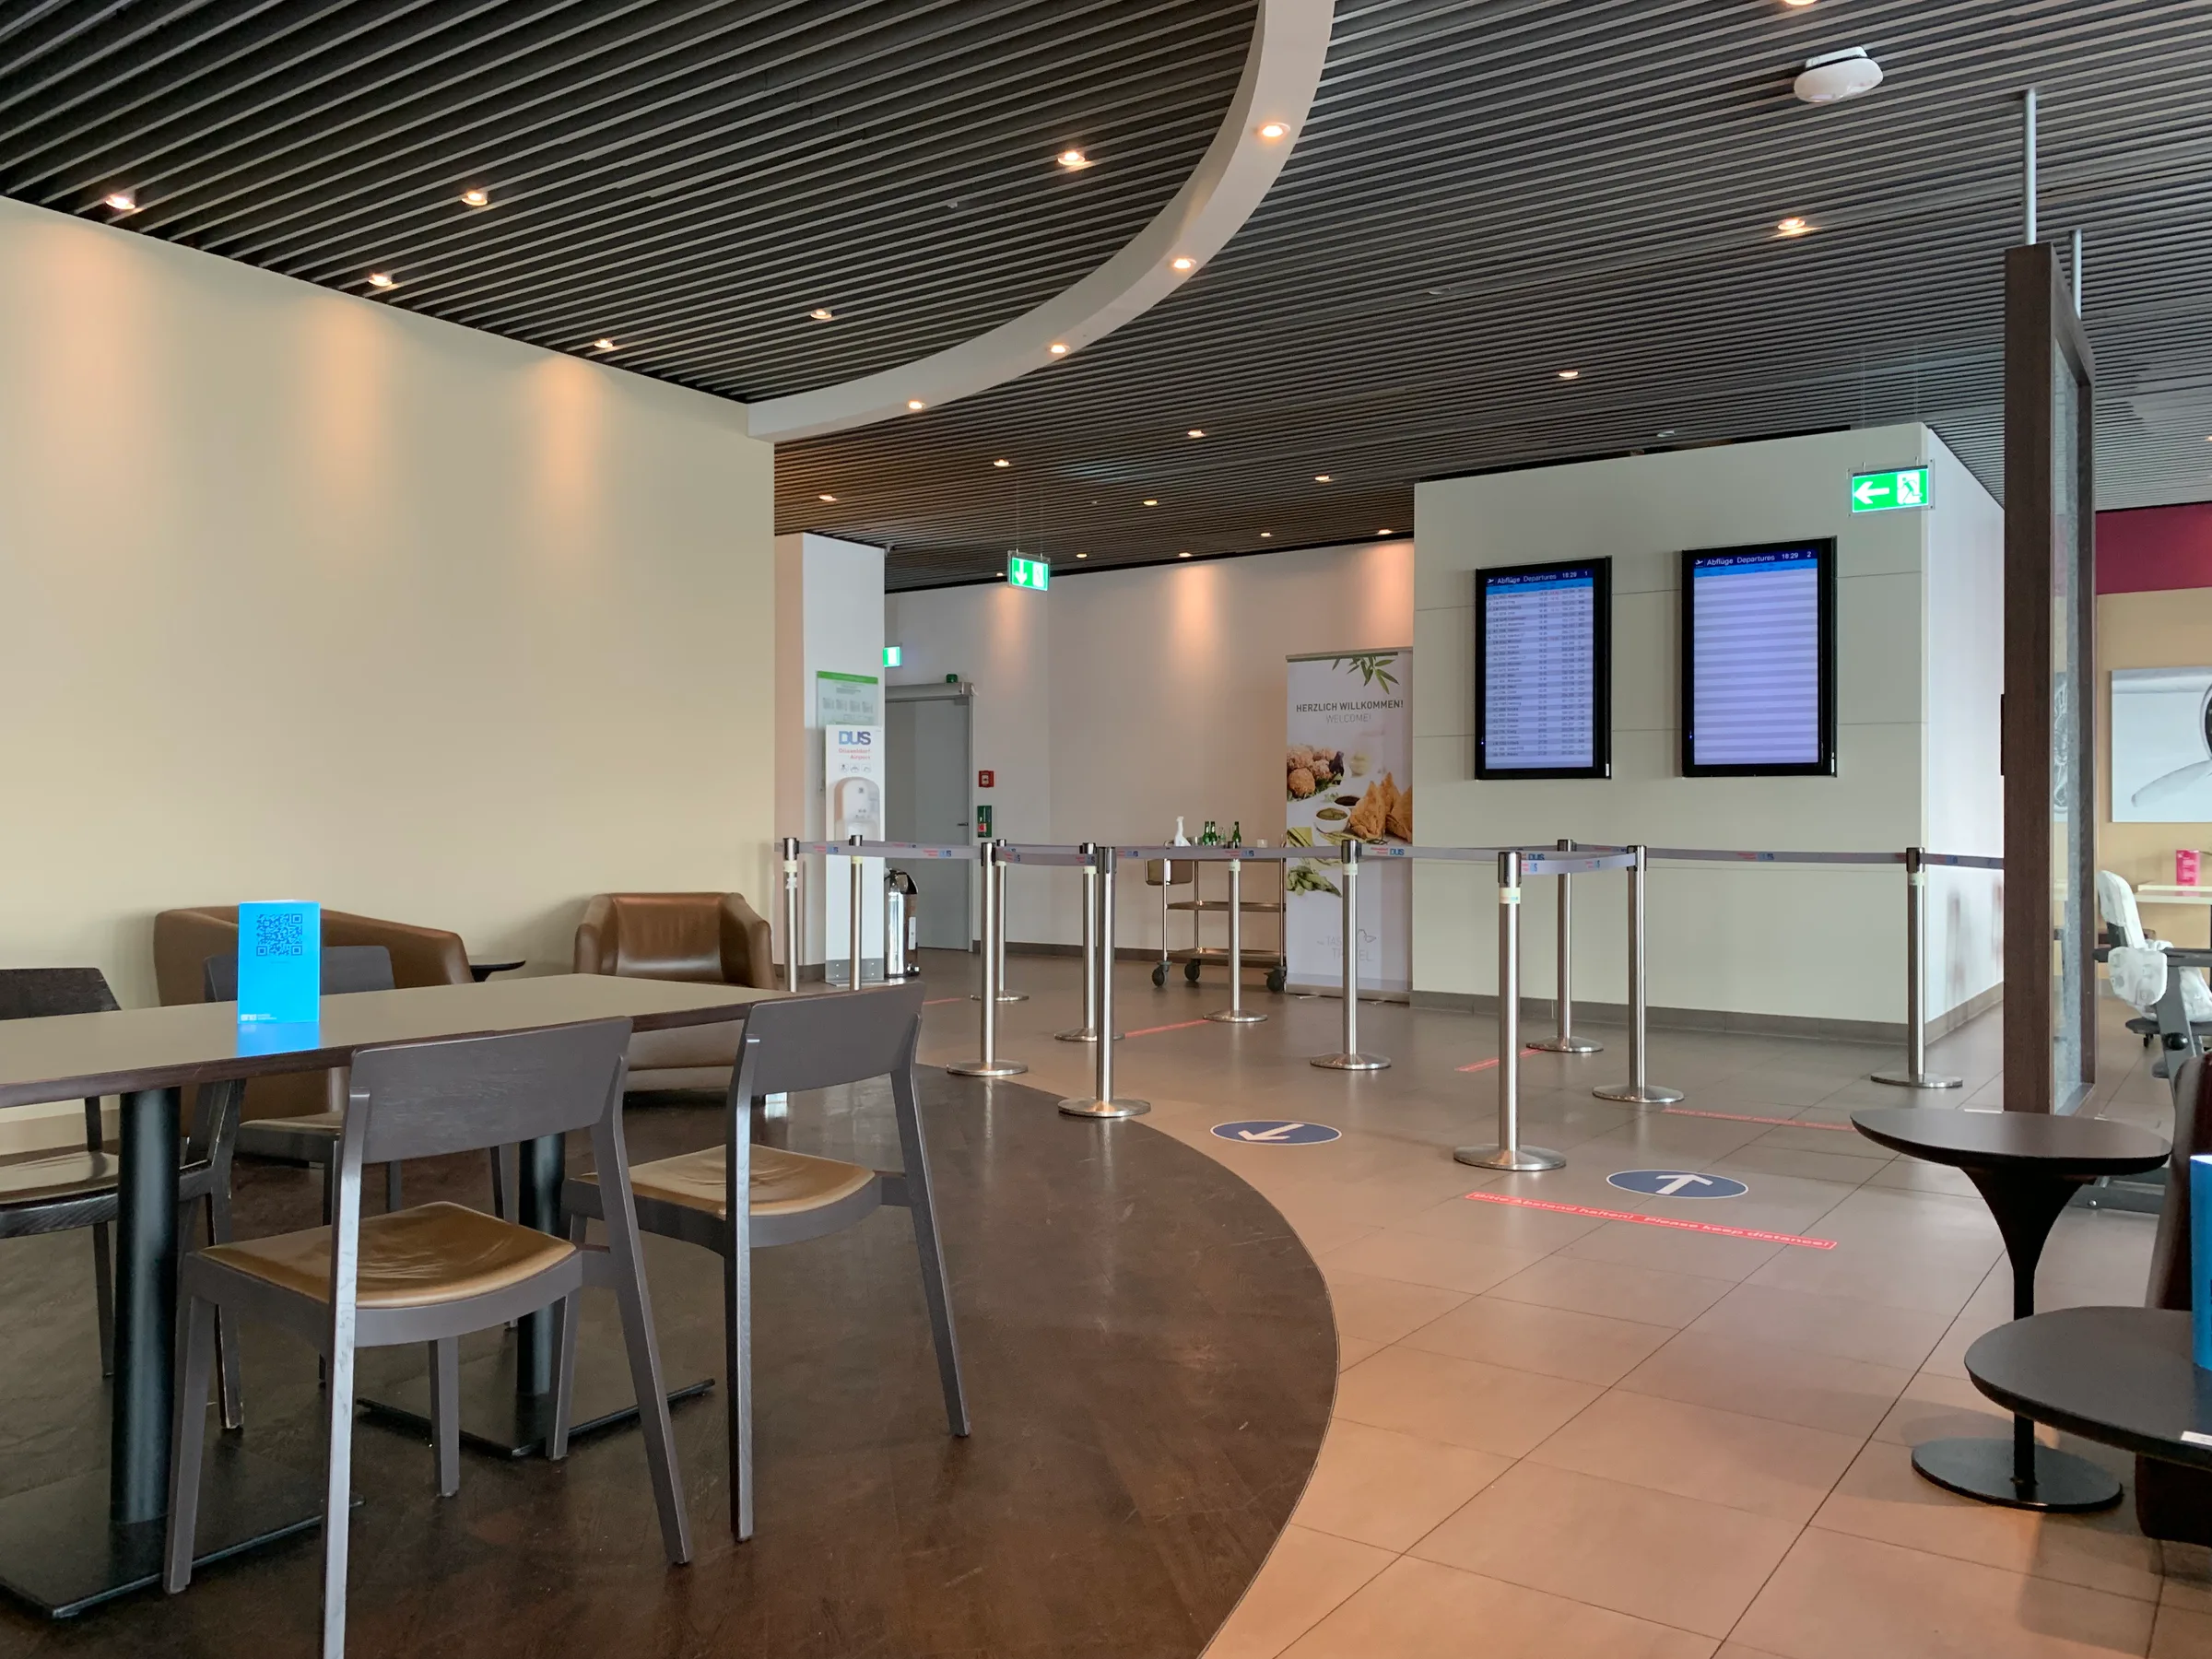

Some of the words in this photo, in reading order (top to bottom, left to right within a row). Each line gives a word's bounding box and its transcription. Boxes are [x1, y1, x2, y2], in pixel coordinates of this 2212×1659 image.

[1707, 559, 1734, 567] Abflüge
[1736, 555, 1775, 564] Departures
[1497, 577, 1521, 585] Abflüge
[1524, 574, 1557, 583] Departures
[1296, 702, 1337, 712] HERZLICH
[1339, 700, 1404, 711] WILLKOMMEN!
[1325, 712, 1371, 724] WELCOME!
[838, 730, 872, 746] DUS
[1389, 848, 1405, 856] DUS
[1474, 1193, 1510, 1202] Bitte
[1512, 1199, 1577, 1212] Abstand
[1579, 1207, 1634, 1219] halten!
[1643, 1217, 1699, 1229] Please
[1702, 1225, 1744, 1235] keep
[1747, 1231, 1830, 1247] distance!
